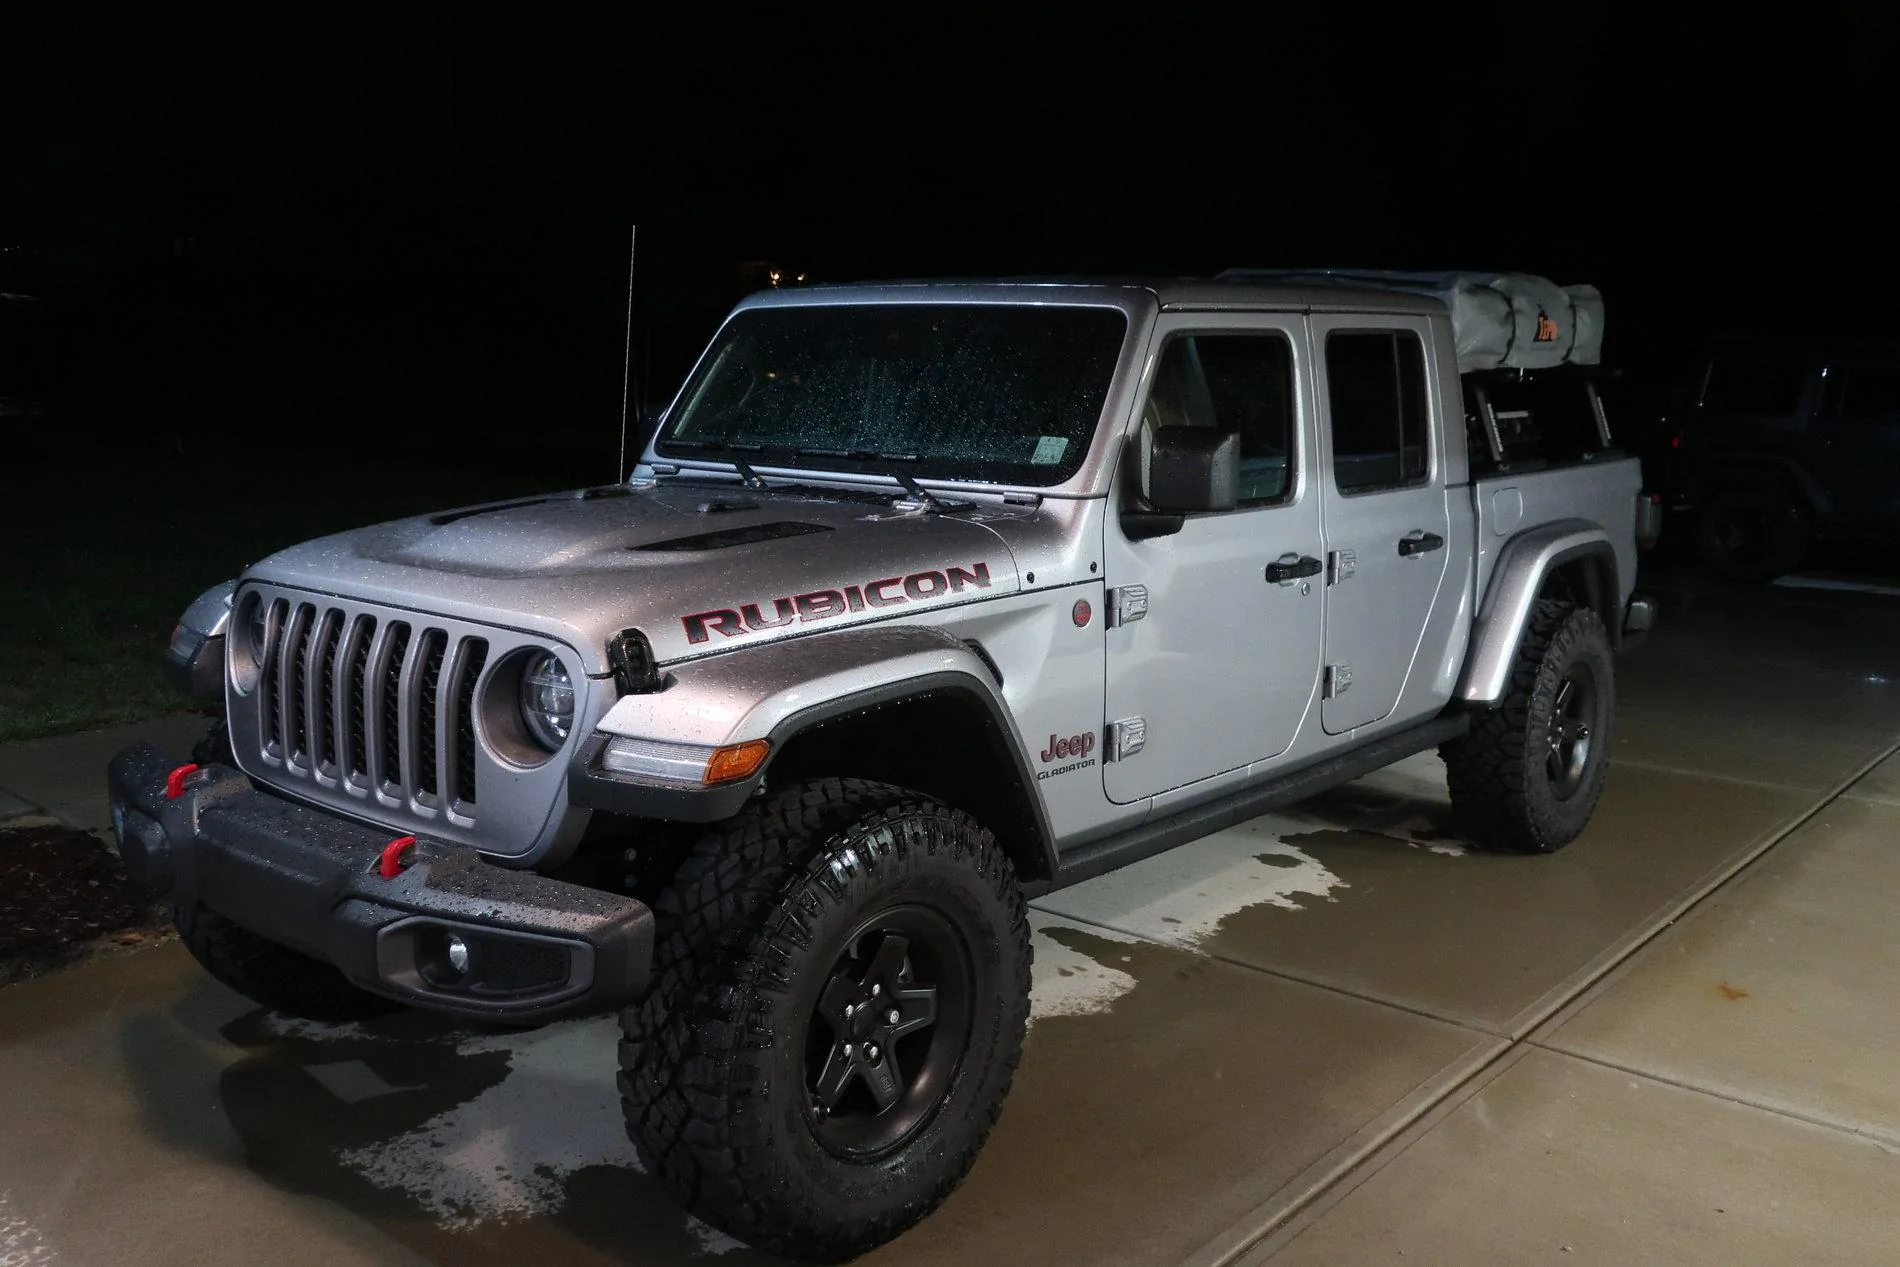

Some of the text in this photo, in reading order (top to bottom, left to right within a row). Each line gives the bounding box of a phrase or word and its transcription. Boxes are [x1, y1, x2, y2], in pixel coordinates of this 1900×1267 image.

[681, 562, 991, 644] RUBICON
[1041, 732, 1095, 763] Jeep
[1037, 759, 1096, 780] GLADIATOR
